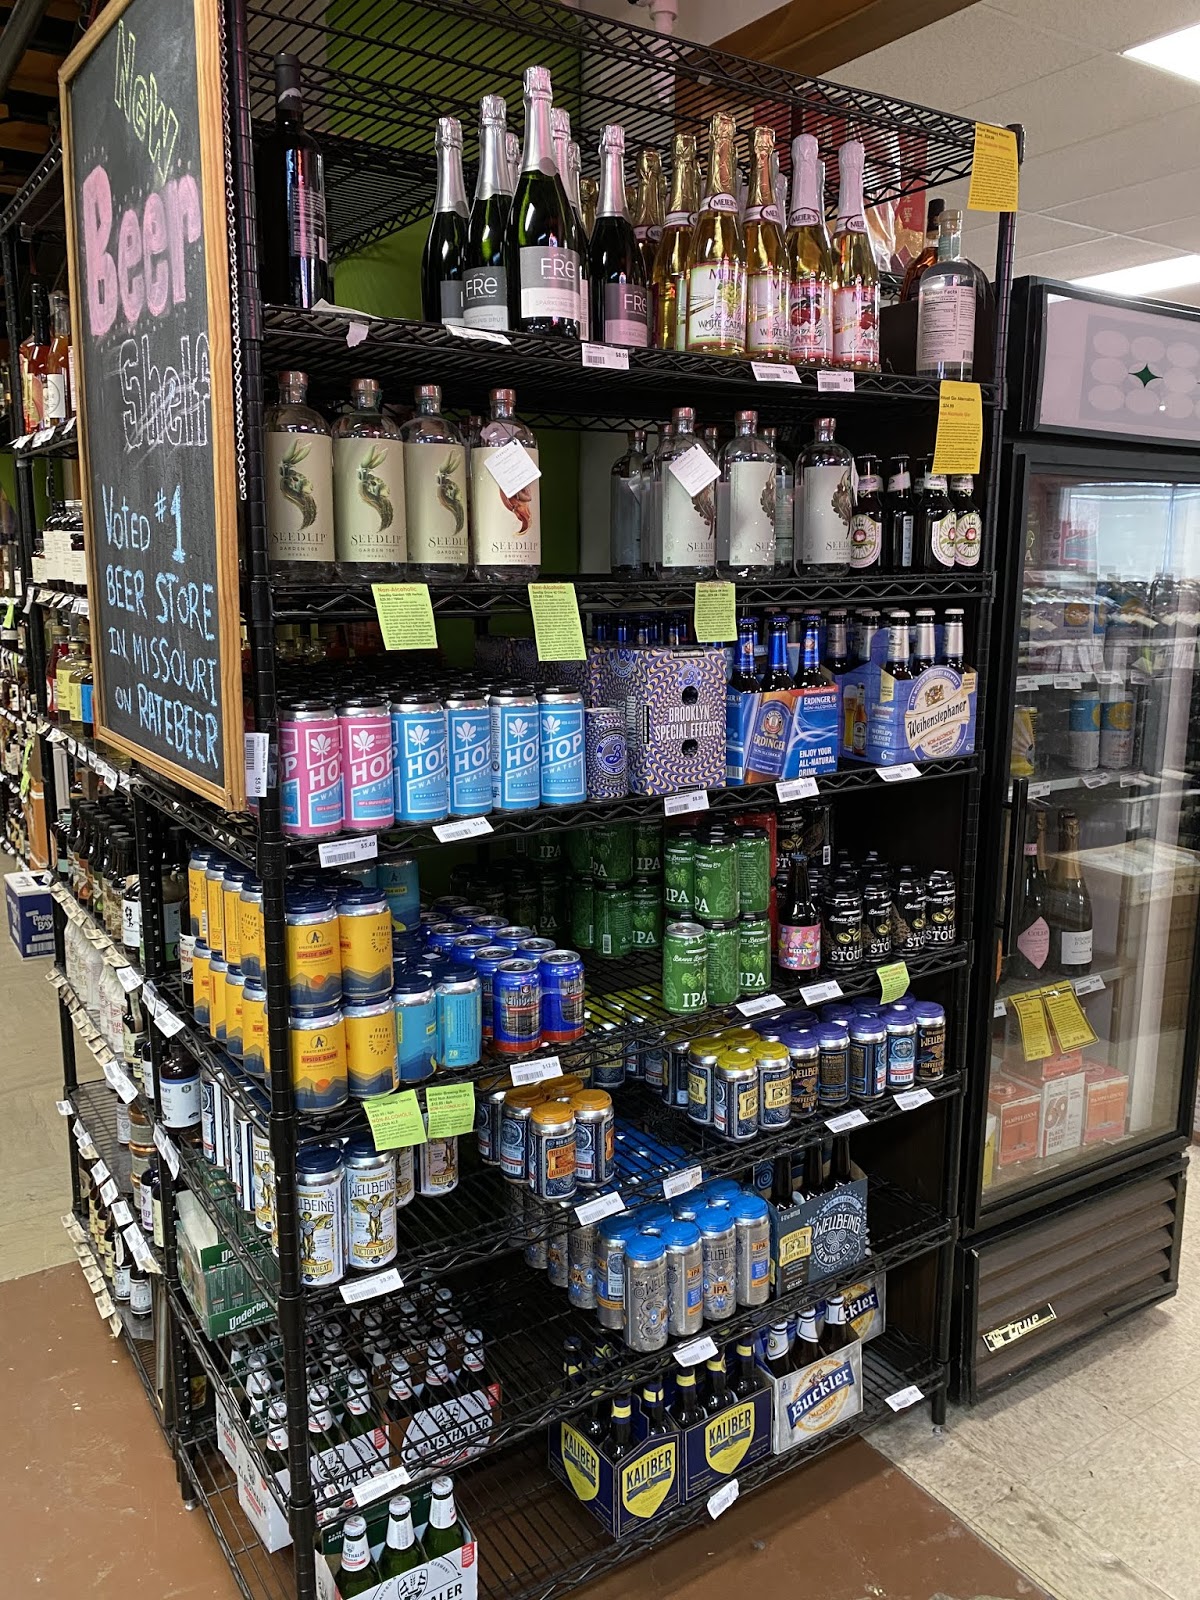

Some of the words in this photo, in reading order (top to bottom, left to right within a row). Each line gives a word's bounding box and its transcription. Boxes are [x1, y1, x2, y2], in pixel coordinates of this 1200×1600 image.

[83, 165, 201, 336] Beer
[272, 531, 327, 544] SEEDLIP
[491, 541, 538, 553] SEEDLIP
[106, 564, 148, 619] BEER
[156, 572, 215, 641] STORE
[109, 626, 130, 663] IN
[133, 633, 218, 708] MISSOURI
[804, 695, 831, 705] ERDINGER
[669, 705, 710, 723] BROOKLYN
[908, 700, 967, 739] Weihenstephaner
[137, 684, 220, 770] RATEBEER
[655, 723, 688, 741] SPECIAL
[690, 721, 722, 739] EFFECTS
[541, 733, 582, 764] HOP
[753, 733, 786, 751] ERDINGER
[799, 748, 816, 758] ENJOY
[818, 746, 832, 755] YOUR
[549, 761, 577, 774] WATER
[799, 755, 836, 767] ALL-NATURAL
[360, 841, 376, 849] $5.49
[637, 857, 661, 870] IPA
[666, 888, 690, 903] IPA
[632, 931, 656, 944] IPA
[740, 972, 767, 986] IPA
[682, 990, 707, 1008] IPA
[813, 1213, 862, 1240] WELLBEING
[354, 1245, 377, 1255] VICTORY
[756, 1243, 766, 1251] IPA
[816, 1243, 841, 1263] BREWING
[311, 1263, 330, 1274] WHEAT
[691, 1268, 700, 1277] IPA
[713, 1285, 728, 1294] IPA
[791, 1368, 850, 1419] Buckler
[709, 1411, 752, 1445] KALIBER
[563, 1430, 597, 1478] KALIBER
[626, 1449, 673, 1488] KALIBER
